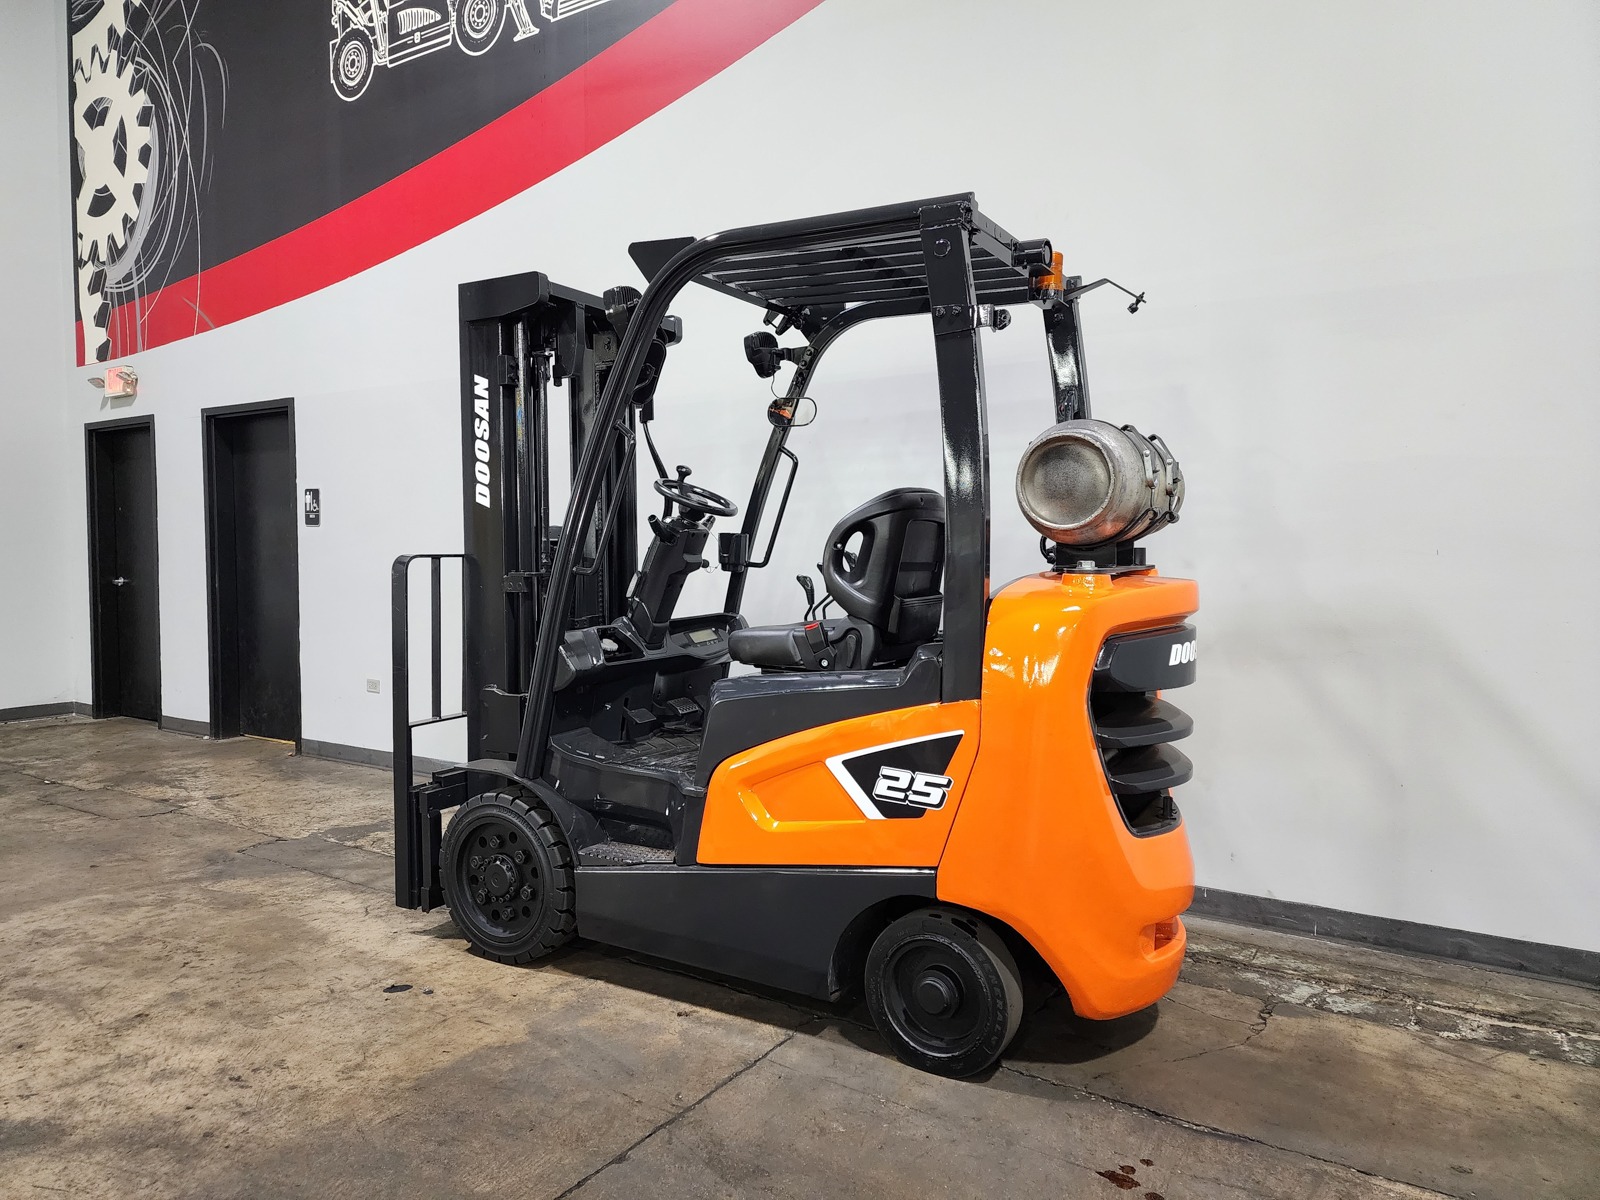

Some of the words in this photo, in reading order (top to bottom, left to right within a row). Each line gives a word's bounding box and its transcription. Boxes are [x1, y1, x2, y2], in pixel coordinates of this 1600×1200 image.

[474, 374, 490, 508] DOOSAN
[1169, 640, 1197, 666] DOO
[873, 766, 954, 810] 25
